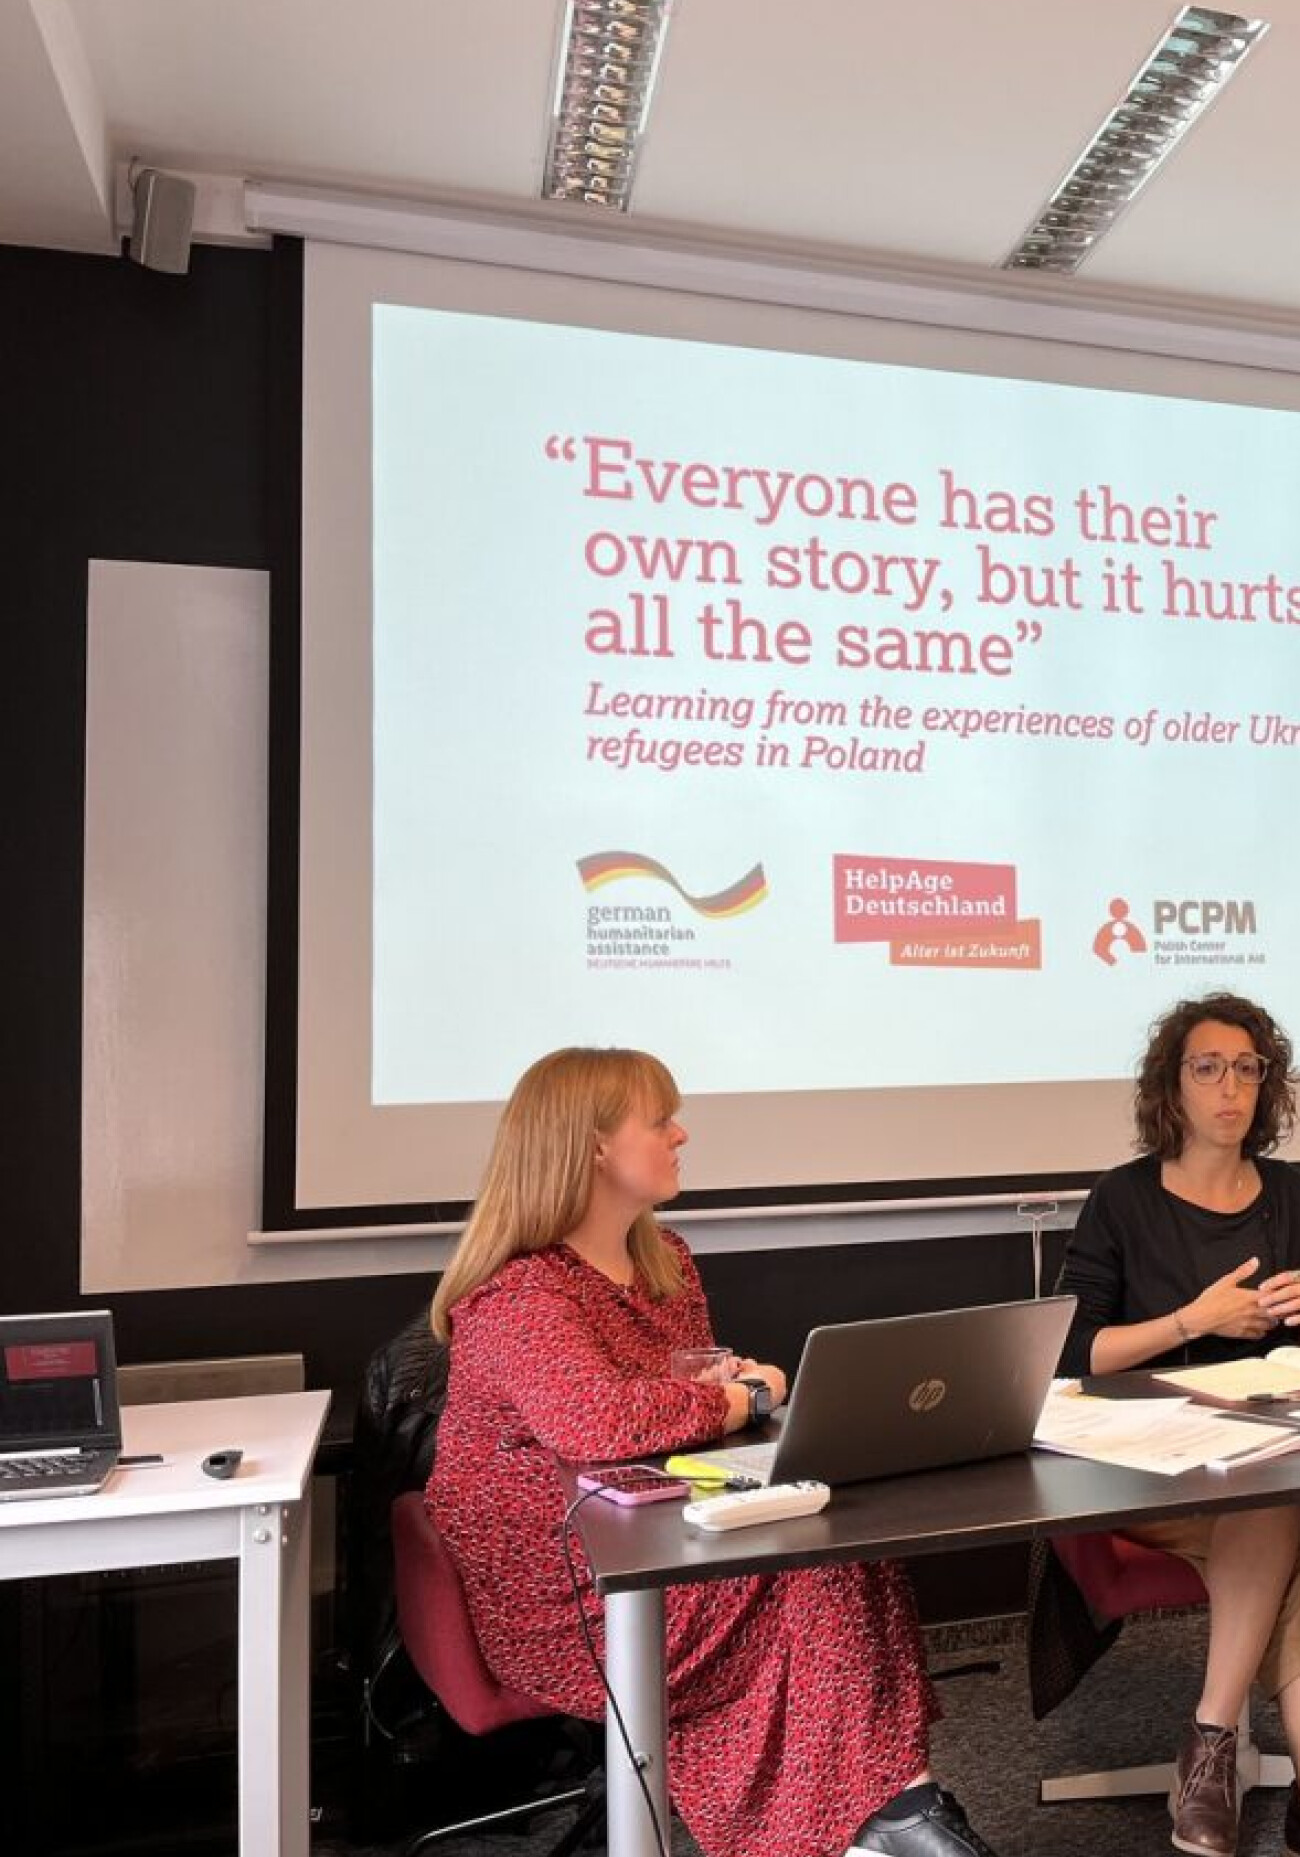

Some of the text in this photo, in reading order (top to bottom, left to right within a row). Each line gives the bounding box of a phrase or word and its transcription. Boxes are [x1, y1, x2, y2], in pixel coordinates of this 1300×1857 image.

[545, 435, 1218, 549] “Everyone has their
[584, 532, 742, 584] own
[768, 537, 953, 612] story,
[977, 545, 1082, 610] but
[1102, 558, 1144, 614] it
[584, 593, 1043, 676] all the same”
[584, 683, 755, 728] Learning
[761, 690, 847, 729] from
[860, 697, 911, 729] the
[922, 705, 1114, 740] experiences
[1124, 710, 1158, 745] of
[1163, 713, 1240, 743] older
[586, 730, 926, 772] refugees in Poland
[845, 869, 953, 893] HelpAge
[587, 906, 671, 924] german
[847, 895, 1006, 915] Deutschland
[1154, 901, 1257, 934] PCPM
[587, 926, 695, 940] humanitarian
[587, 943, 669, 955] assistance
